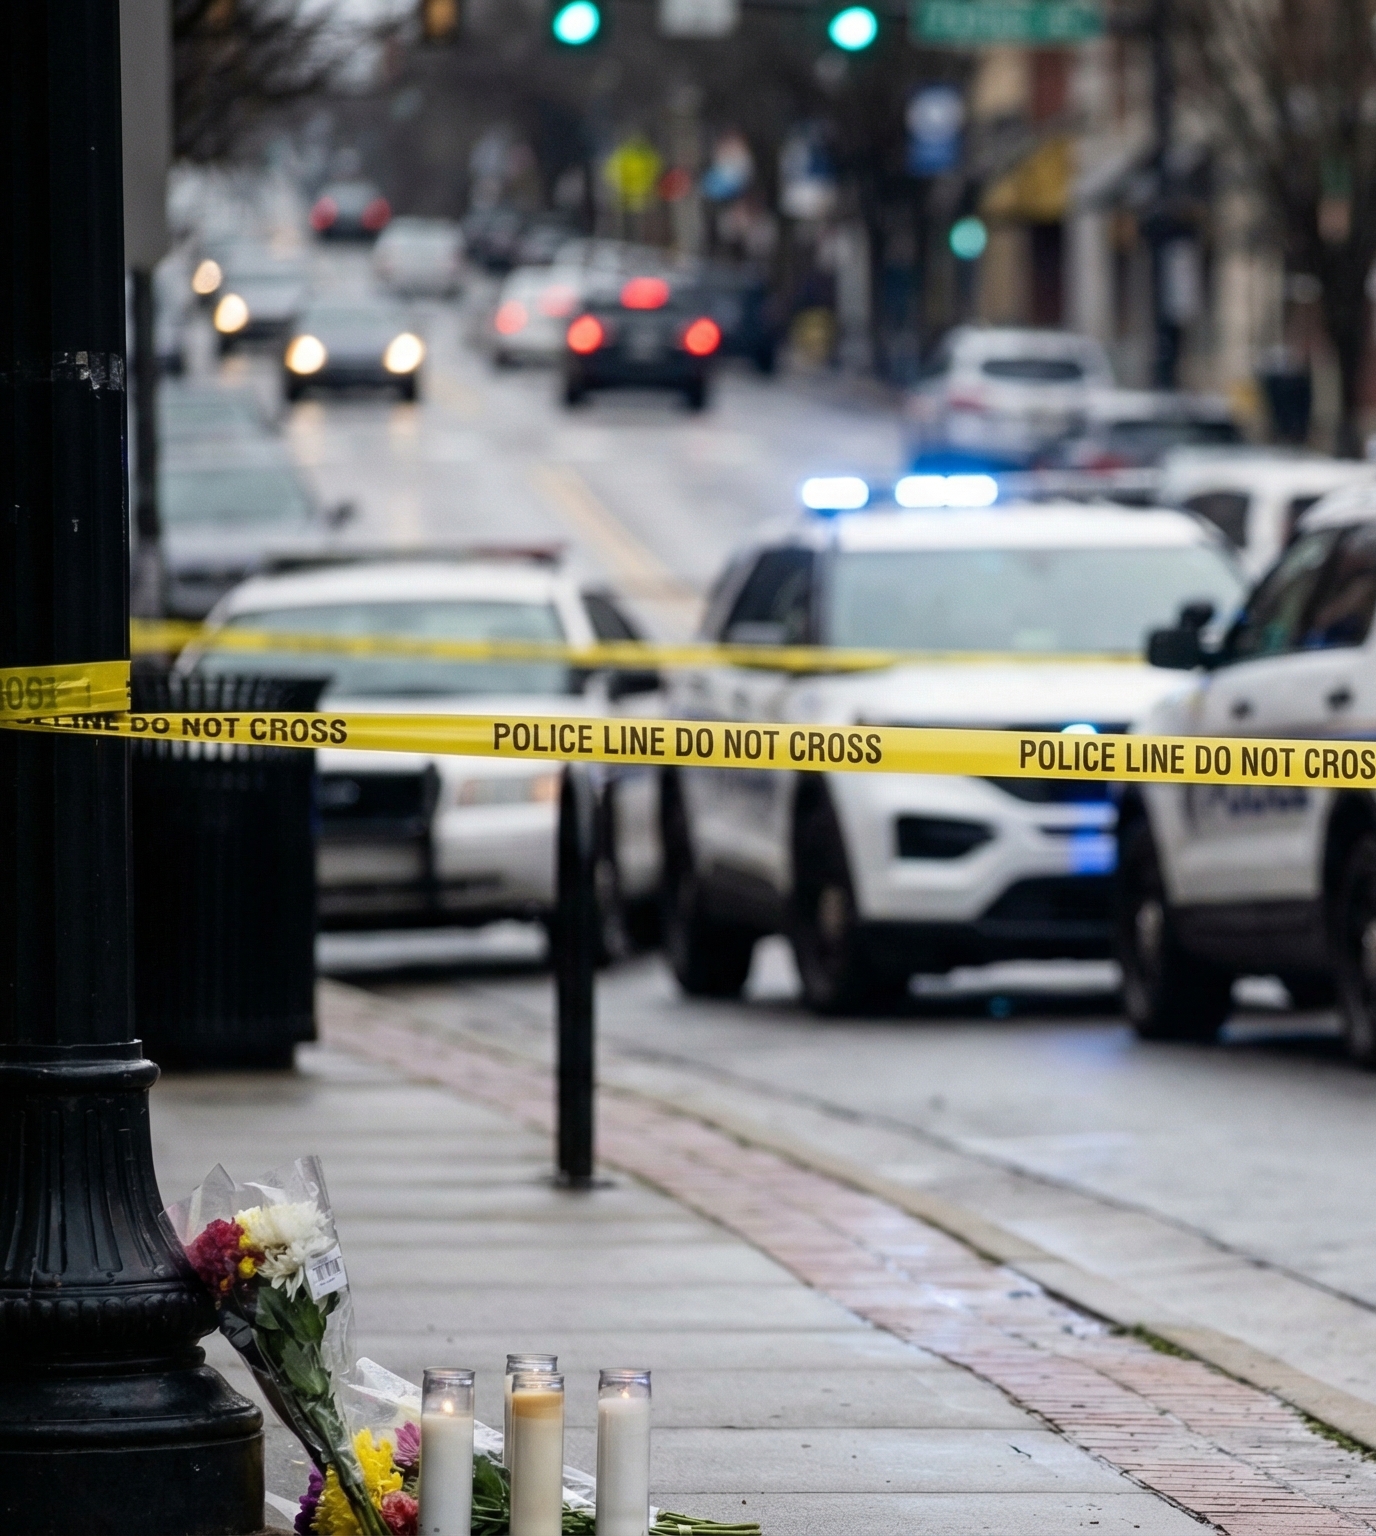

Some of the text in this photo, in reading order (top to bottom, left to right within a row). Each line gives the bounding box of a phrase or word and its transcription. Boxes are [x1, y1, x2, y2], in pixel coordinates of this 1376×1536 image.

[130, 716, 170, 734] DO
[182, 717, 240, 738] NOT
[250, 717, 347, 744] CROSS
[494, 722, 881, 764] POLICE LINE DO NOT CROSS
[1021, 739, 1115, 771] POLICE
[1127, 743, 1184, 773] LINE
[1196, 745, 1230, 775] DO
[1242, 746, 1295, 777] NOT
